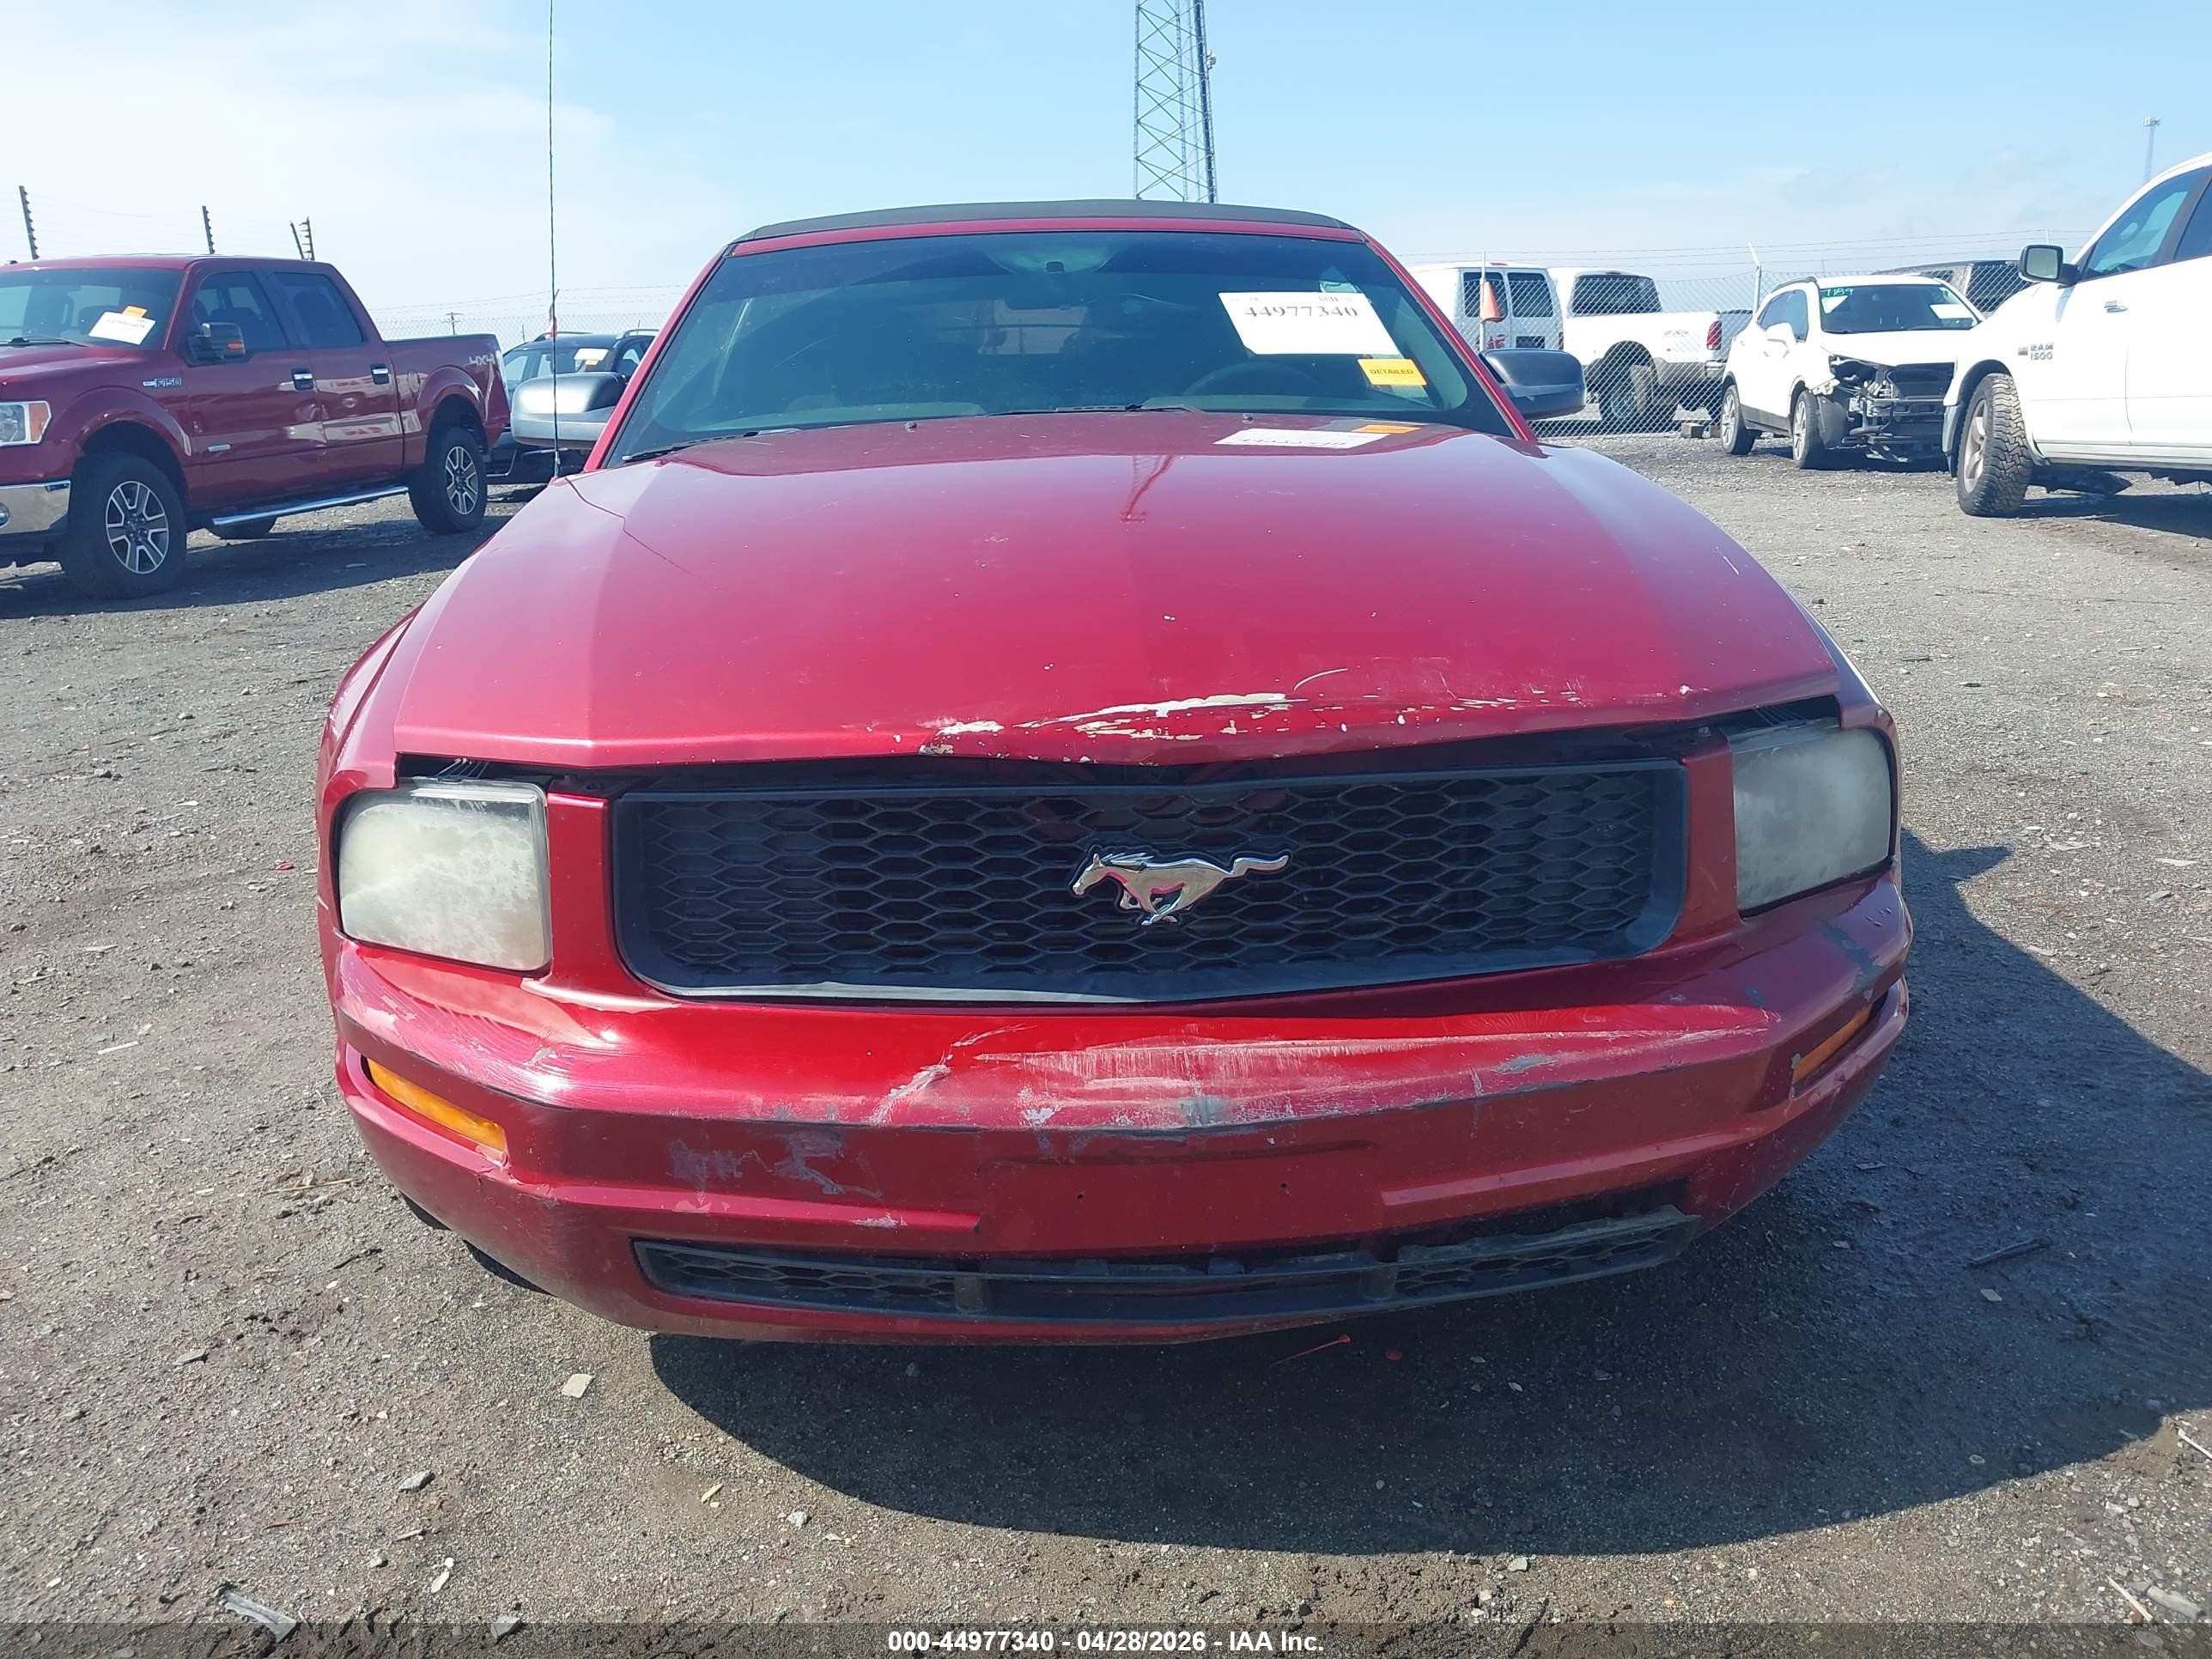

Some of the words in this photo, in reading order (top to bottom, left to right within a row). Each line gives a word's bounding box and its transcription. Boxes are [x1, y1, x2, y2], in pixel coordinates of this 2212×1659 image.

[1244, 306, 1358, 317] 44977340
[2030, 343, 2054, 351] RAM
[2030, 352, 2053, 361] 1500
